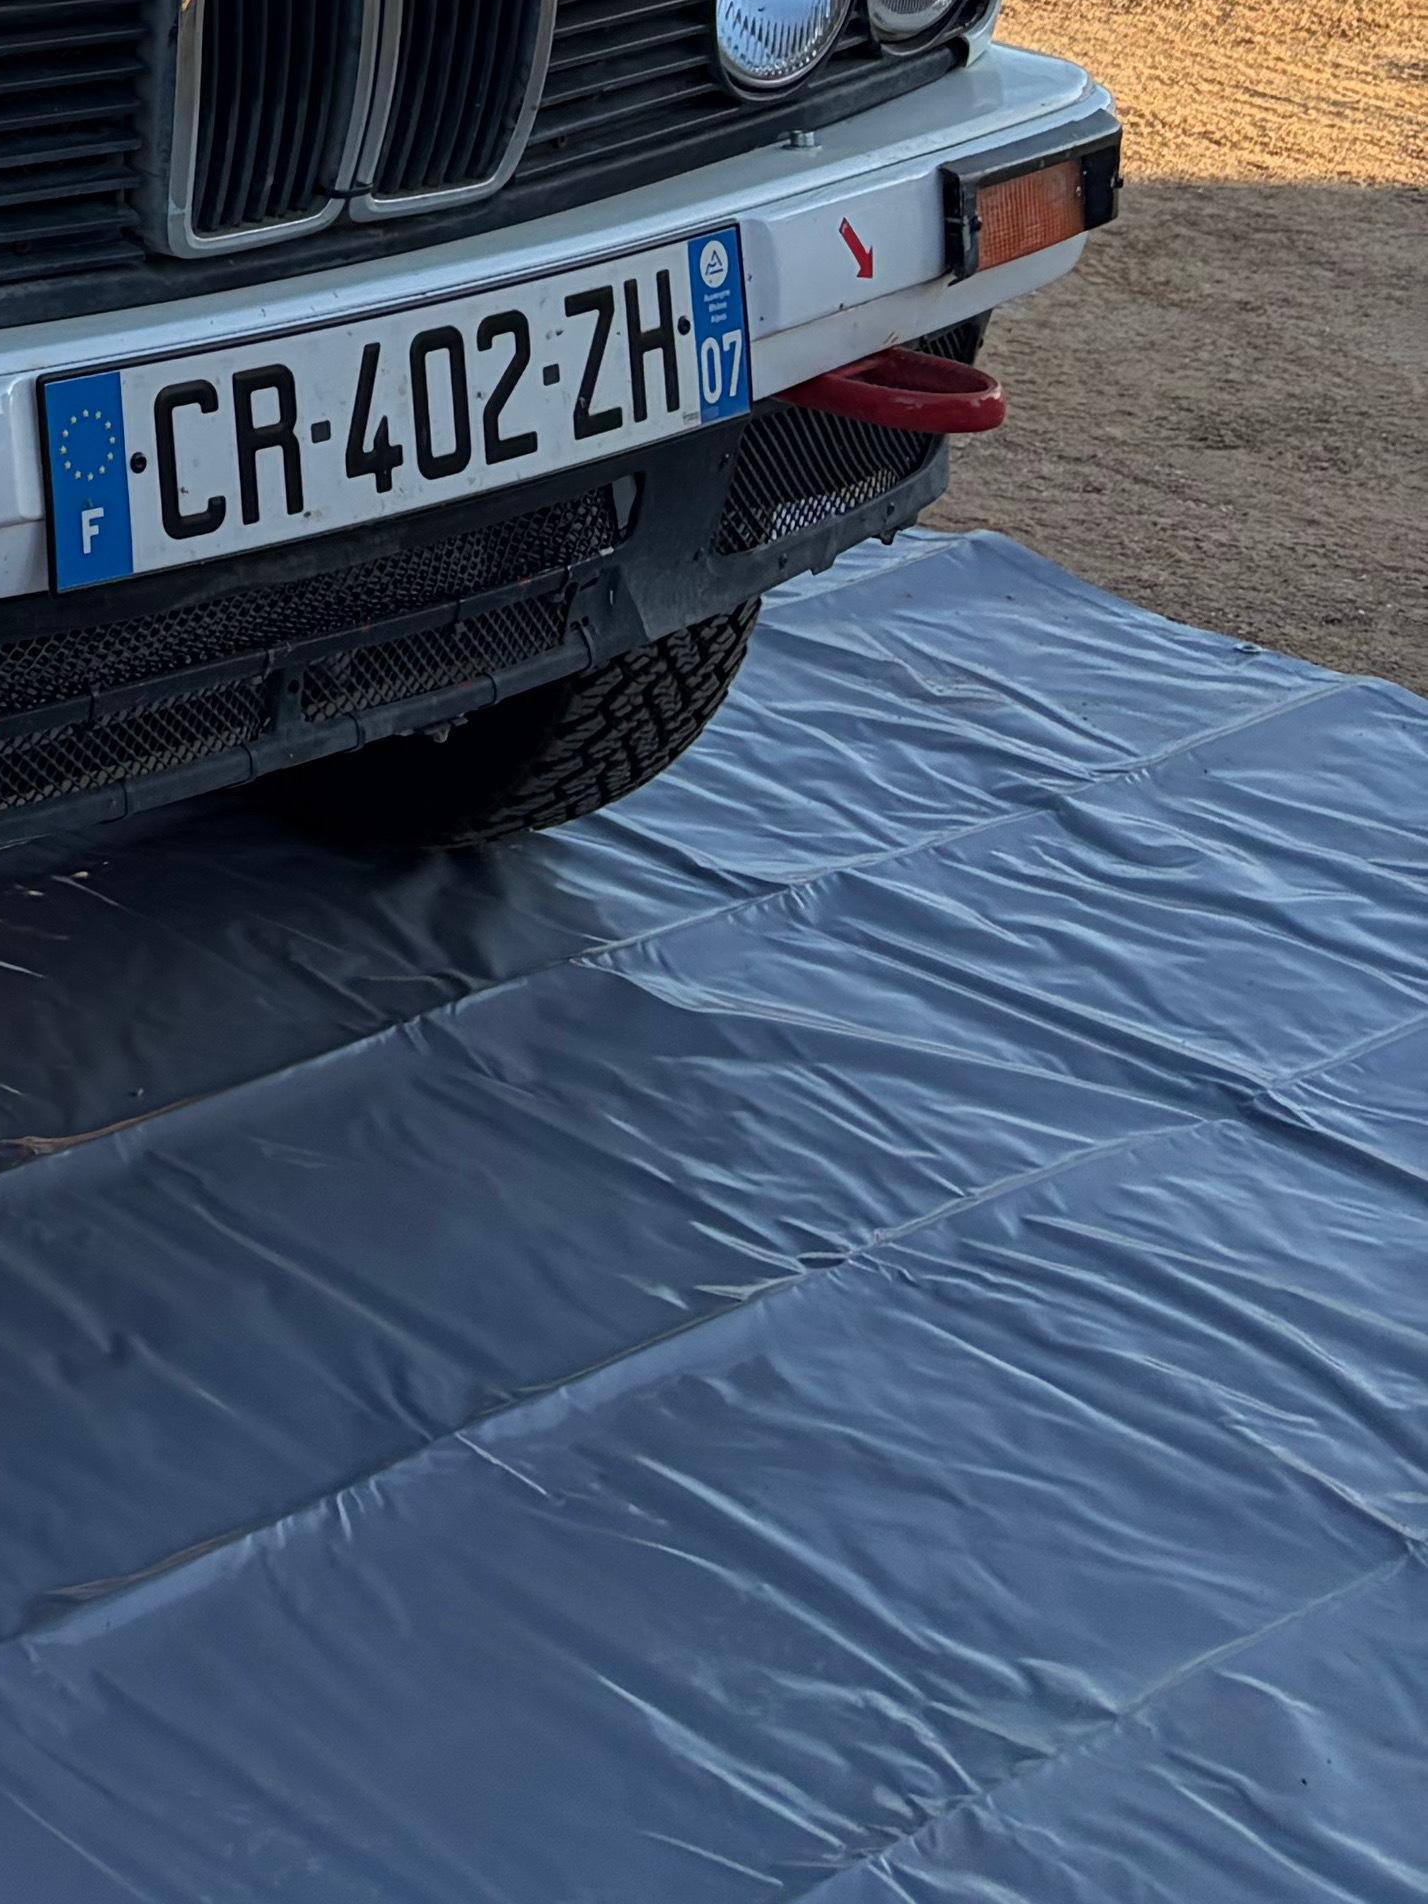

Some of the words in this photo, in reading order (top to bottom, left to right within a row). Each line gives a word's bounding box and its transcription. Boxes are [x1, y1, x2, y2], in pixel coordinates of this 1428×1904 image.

[154, 268, 682, 541] CR-402-ZH
[700, 329, 742, 405] 07
[81, 505, 105, 555] F
